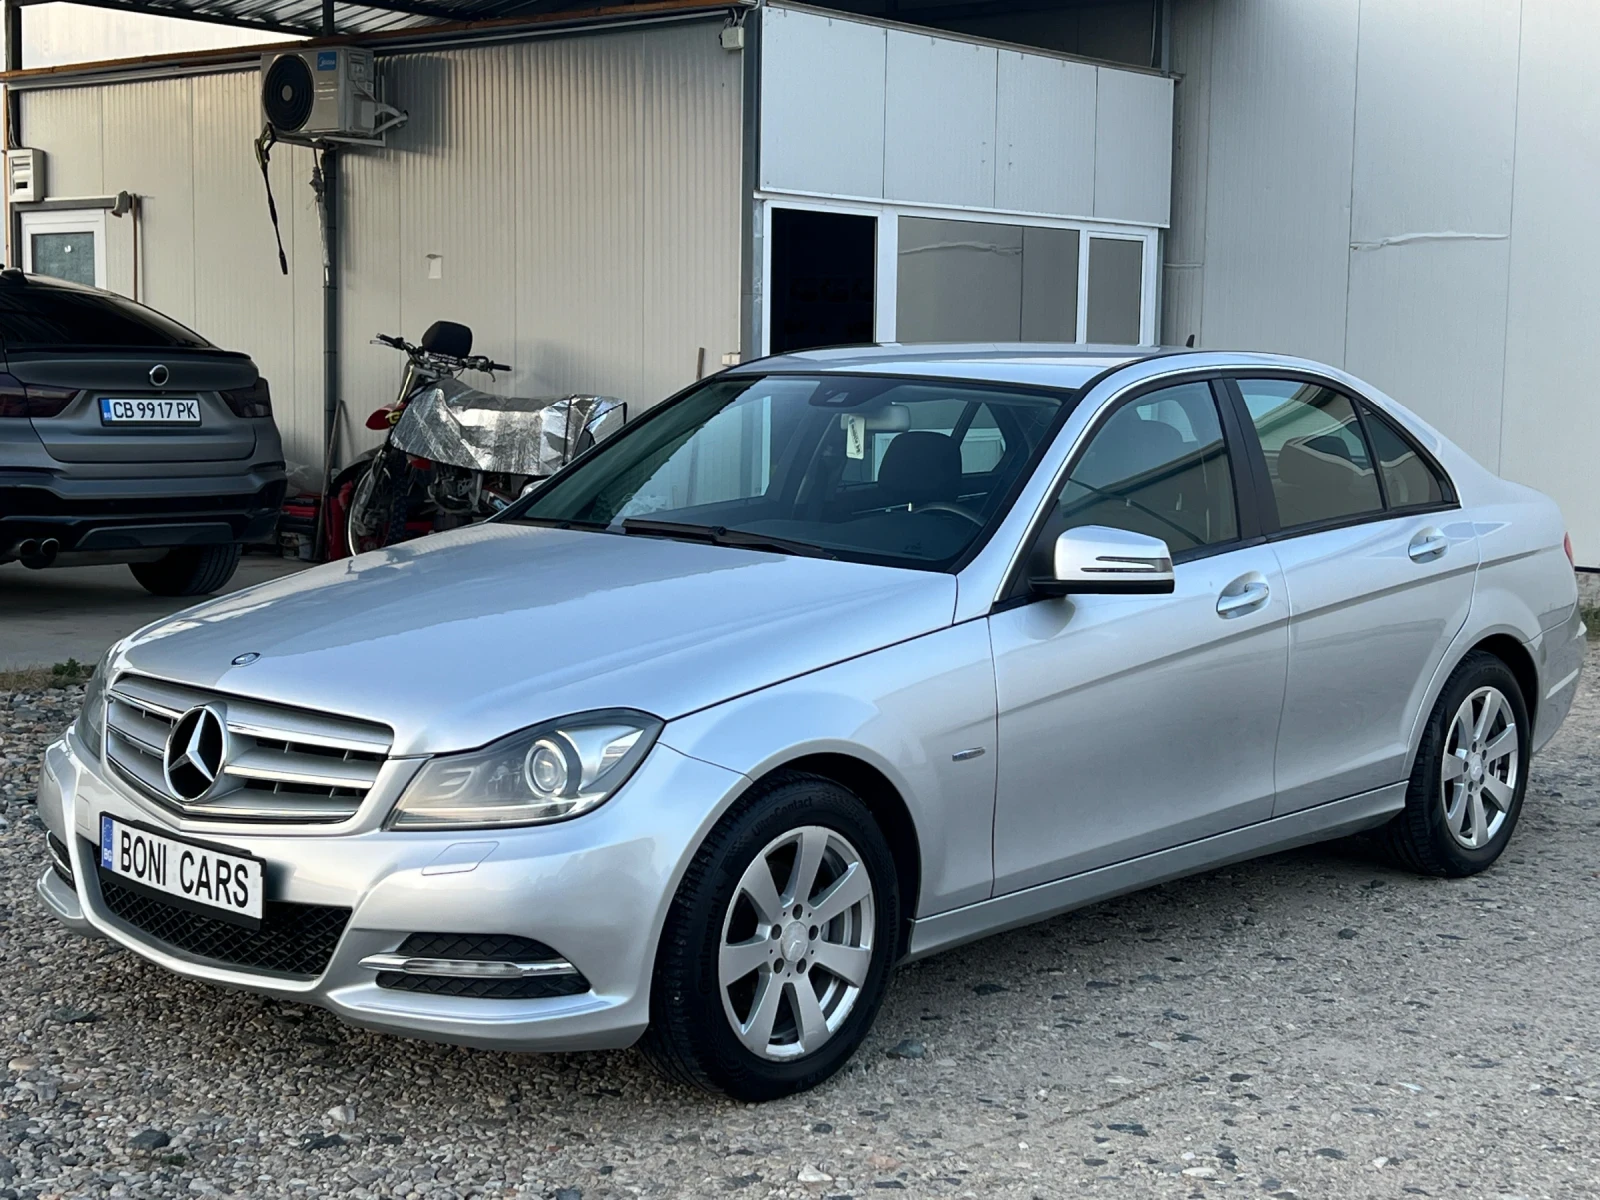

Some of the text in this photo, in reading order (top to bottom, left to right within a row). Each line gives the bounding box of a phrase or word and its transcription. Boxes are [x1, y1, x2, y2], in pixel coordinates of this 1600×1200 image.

[113, 402, 197, 419] CB 9917 PK
[121, 830, 249, 908] BONI CARS
